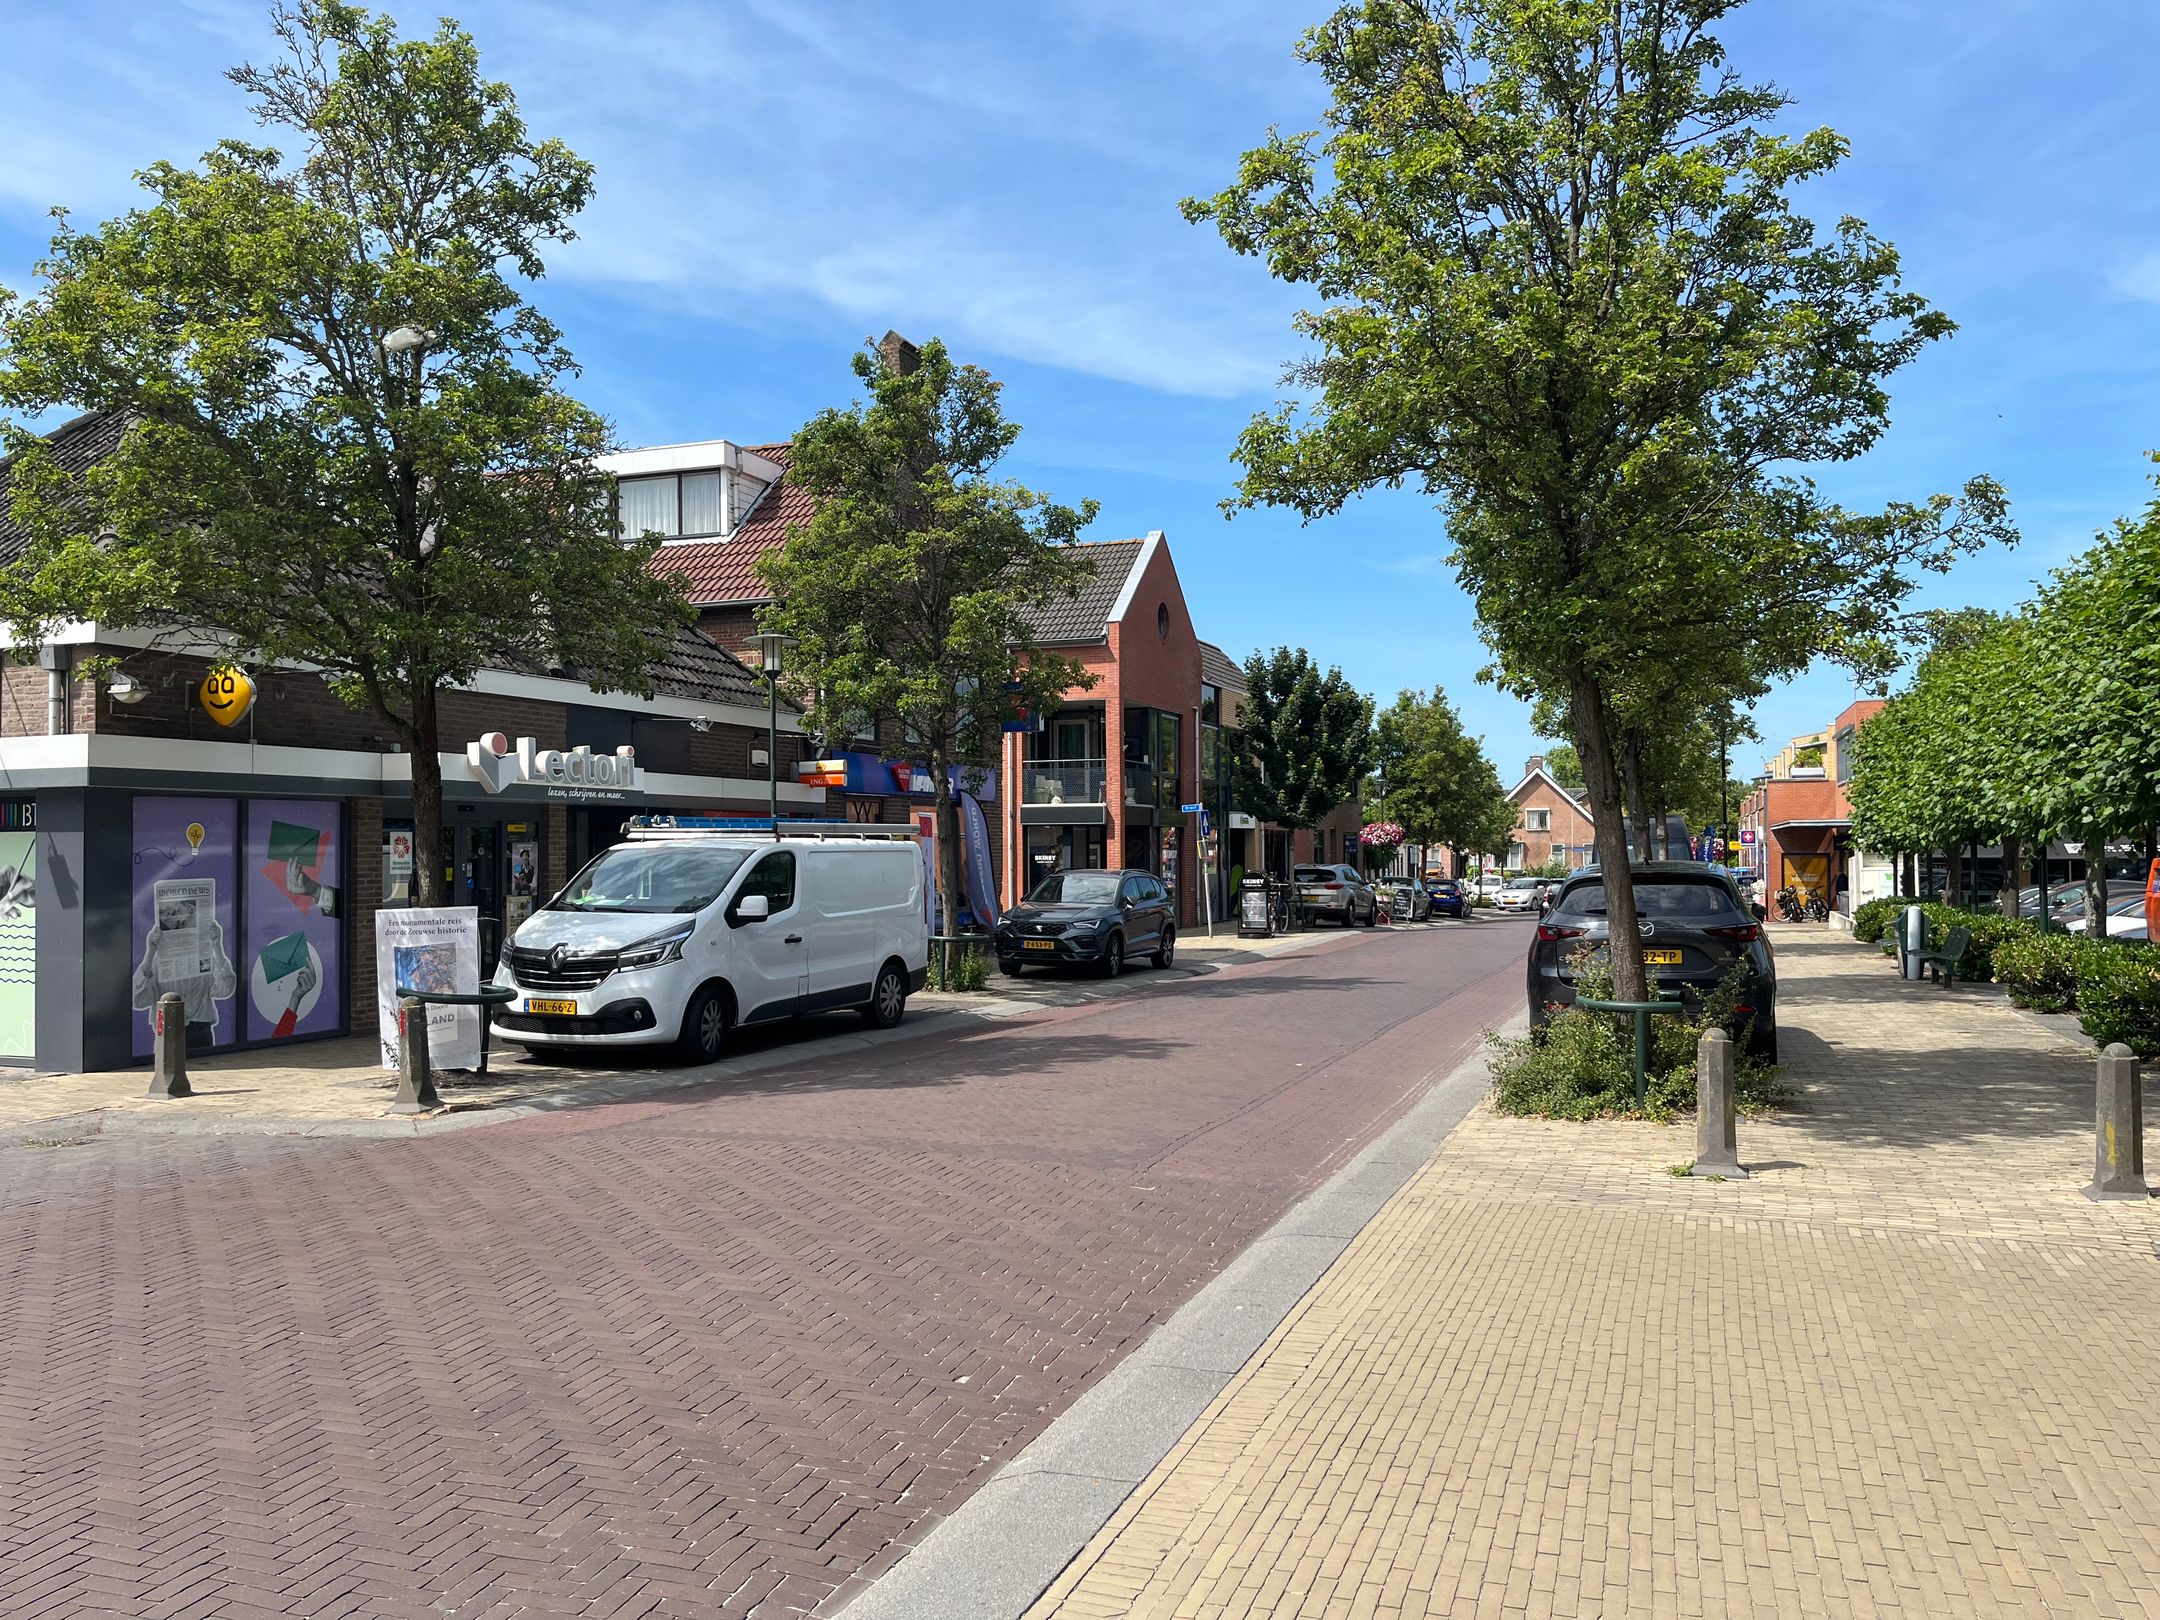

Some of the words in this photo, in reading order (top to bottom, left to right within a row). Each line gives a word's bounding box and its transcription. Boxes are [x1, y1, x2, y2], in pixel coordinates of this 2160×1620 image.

[518, 737, 635, 786] Lectori
[547, 787, 567, 798] lezen,
[568, 788, 597, 801] schrijven
[388, 919, 400, 927] Een
[400, 917, 446, 926] monumentale
[447, 917, 462, 925] reis
[384, 928, 399, 936] door
[400, 928, 407, 936] de
[408, 927, 436, 935] Zeeuwse
[437, 926, 467, 934] historie
[531, 1001, 573, 1013] VHL-66-Z
